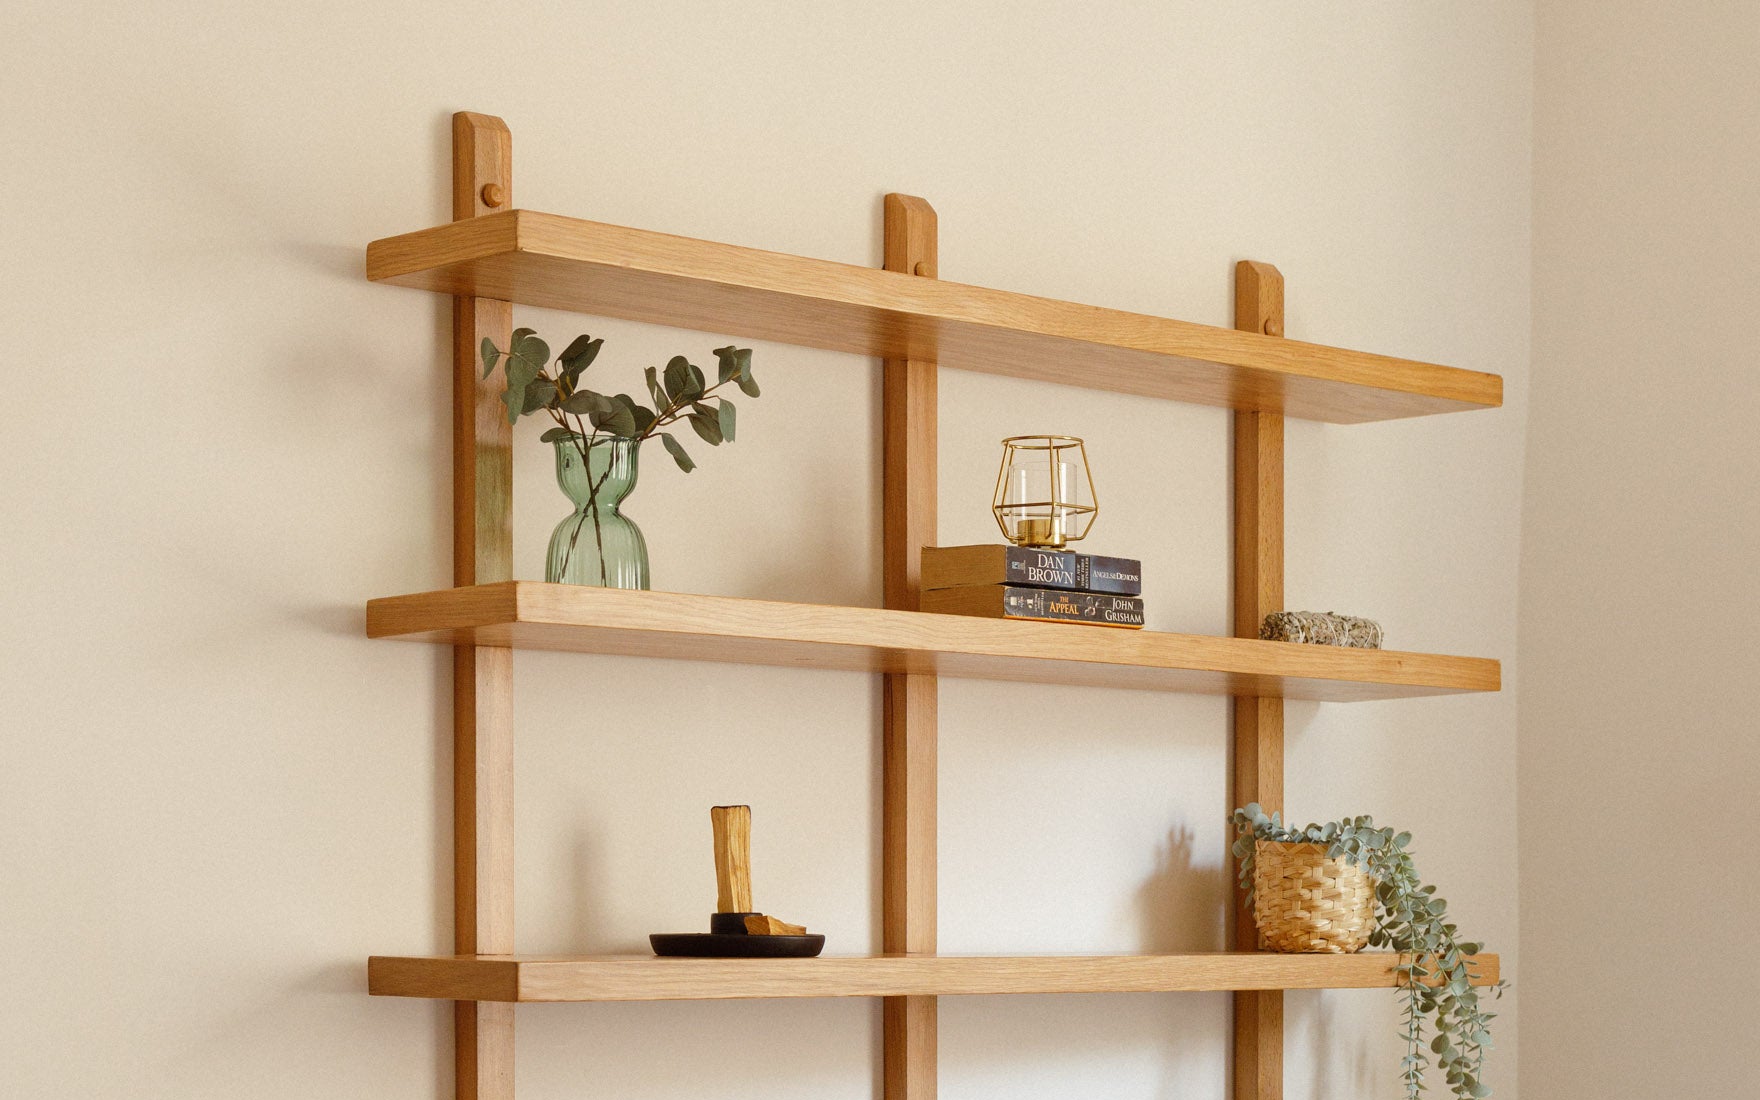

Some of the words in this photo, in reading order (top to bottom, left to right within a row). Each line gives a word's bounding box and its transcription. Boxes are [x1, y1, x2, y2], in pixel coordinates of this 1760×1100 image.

[1038, 553, 1064, 571] DAN
[1028, 566, 1074, 585] BROWN
[1049, 601, 1080, 615] APPEAL
[1112, 598, 1134, 611] JOHN
[1105, 609, 1142, 624] GRISHAM
